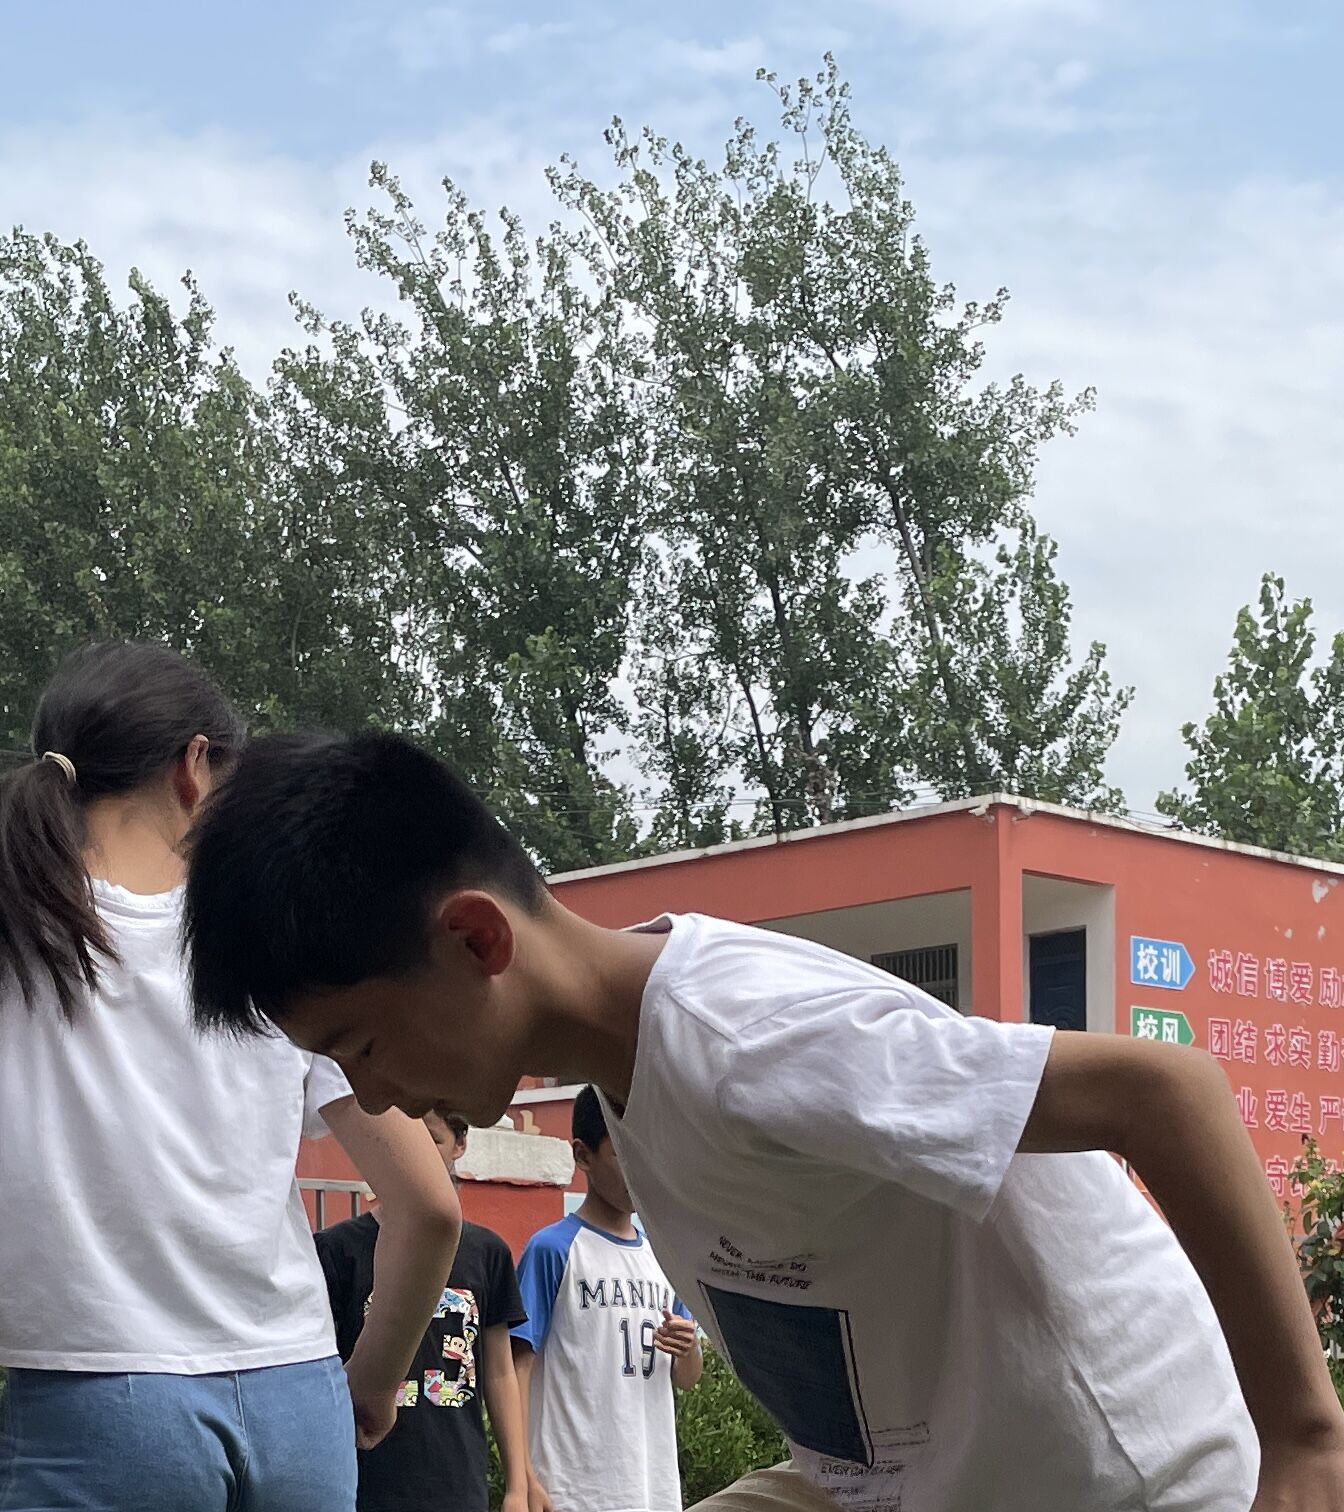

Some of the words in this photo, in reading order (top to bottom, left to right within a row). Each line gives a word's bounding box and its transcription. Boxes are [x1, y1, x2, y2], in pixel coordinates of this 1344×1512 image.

[1136, 942, 1181, 985] 校训
[1207, 948, 1259, 999] 诚信
[1264, 956, 1313, 1005] 博爱
[1136, 1012, 1180, 1045] 校风
[1207, 1016, 1257, 1065] 团结
[1264, 1022, 1312, 1071] 求实
[1264, 1089, 1313, 1134] 爱生
